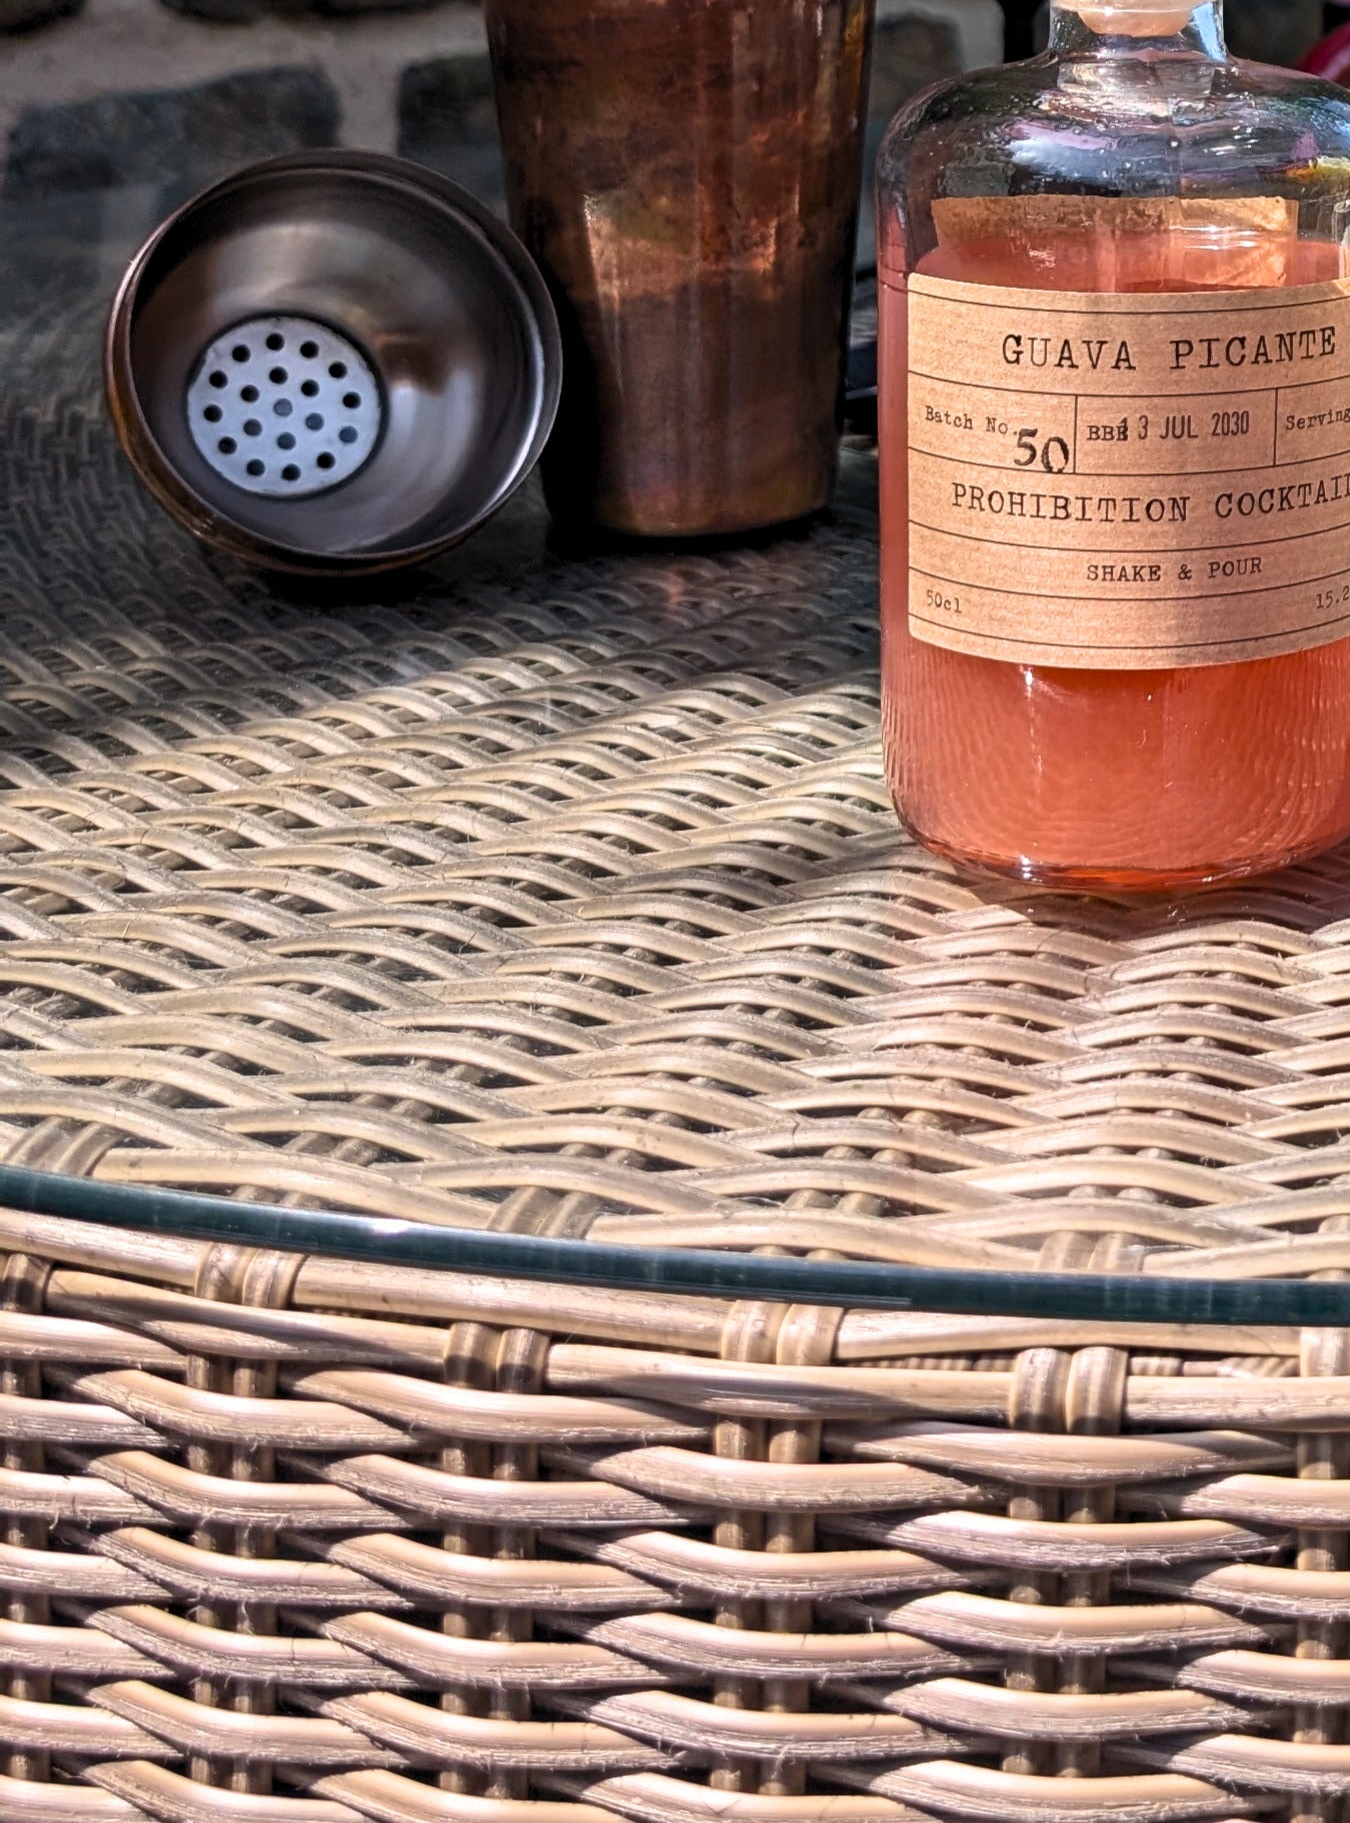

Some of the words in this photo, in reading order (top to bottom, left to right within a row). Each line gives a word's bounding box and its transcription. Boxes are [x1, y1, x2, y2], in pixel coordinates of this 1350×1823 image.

[1001, 333, 1136, 371] GUAVA
[1169, 326, 1336, 370] PICANTE
[924, 405, 974, 430] Batch
[985, 416, 1017, 436] No.
[1013, 428, 1070, 474] 50
[1159, 415, 1199, 441] JUL
[1211, 410, 1250, 437] 2030
[952, 482, 1190, 523] PROHIBITION
[1086, 564, 1161, 583] SHAKE
[1177, 564, 1193, 581] &
[1208, 556, 1263, 579] POUR
[926, 589, 962, 614] 50cl
